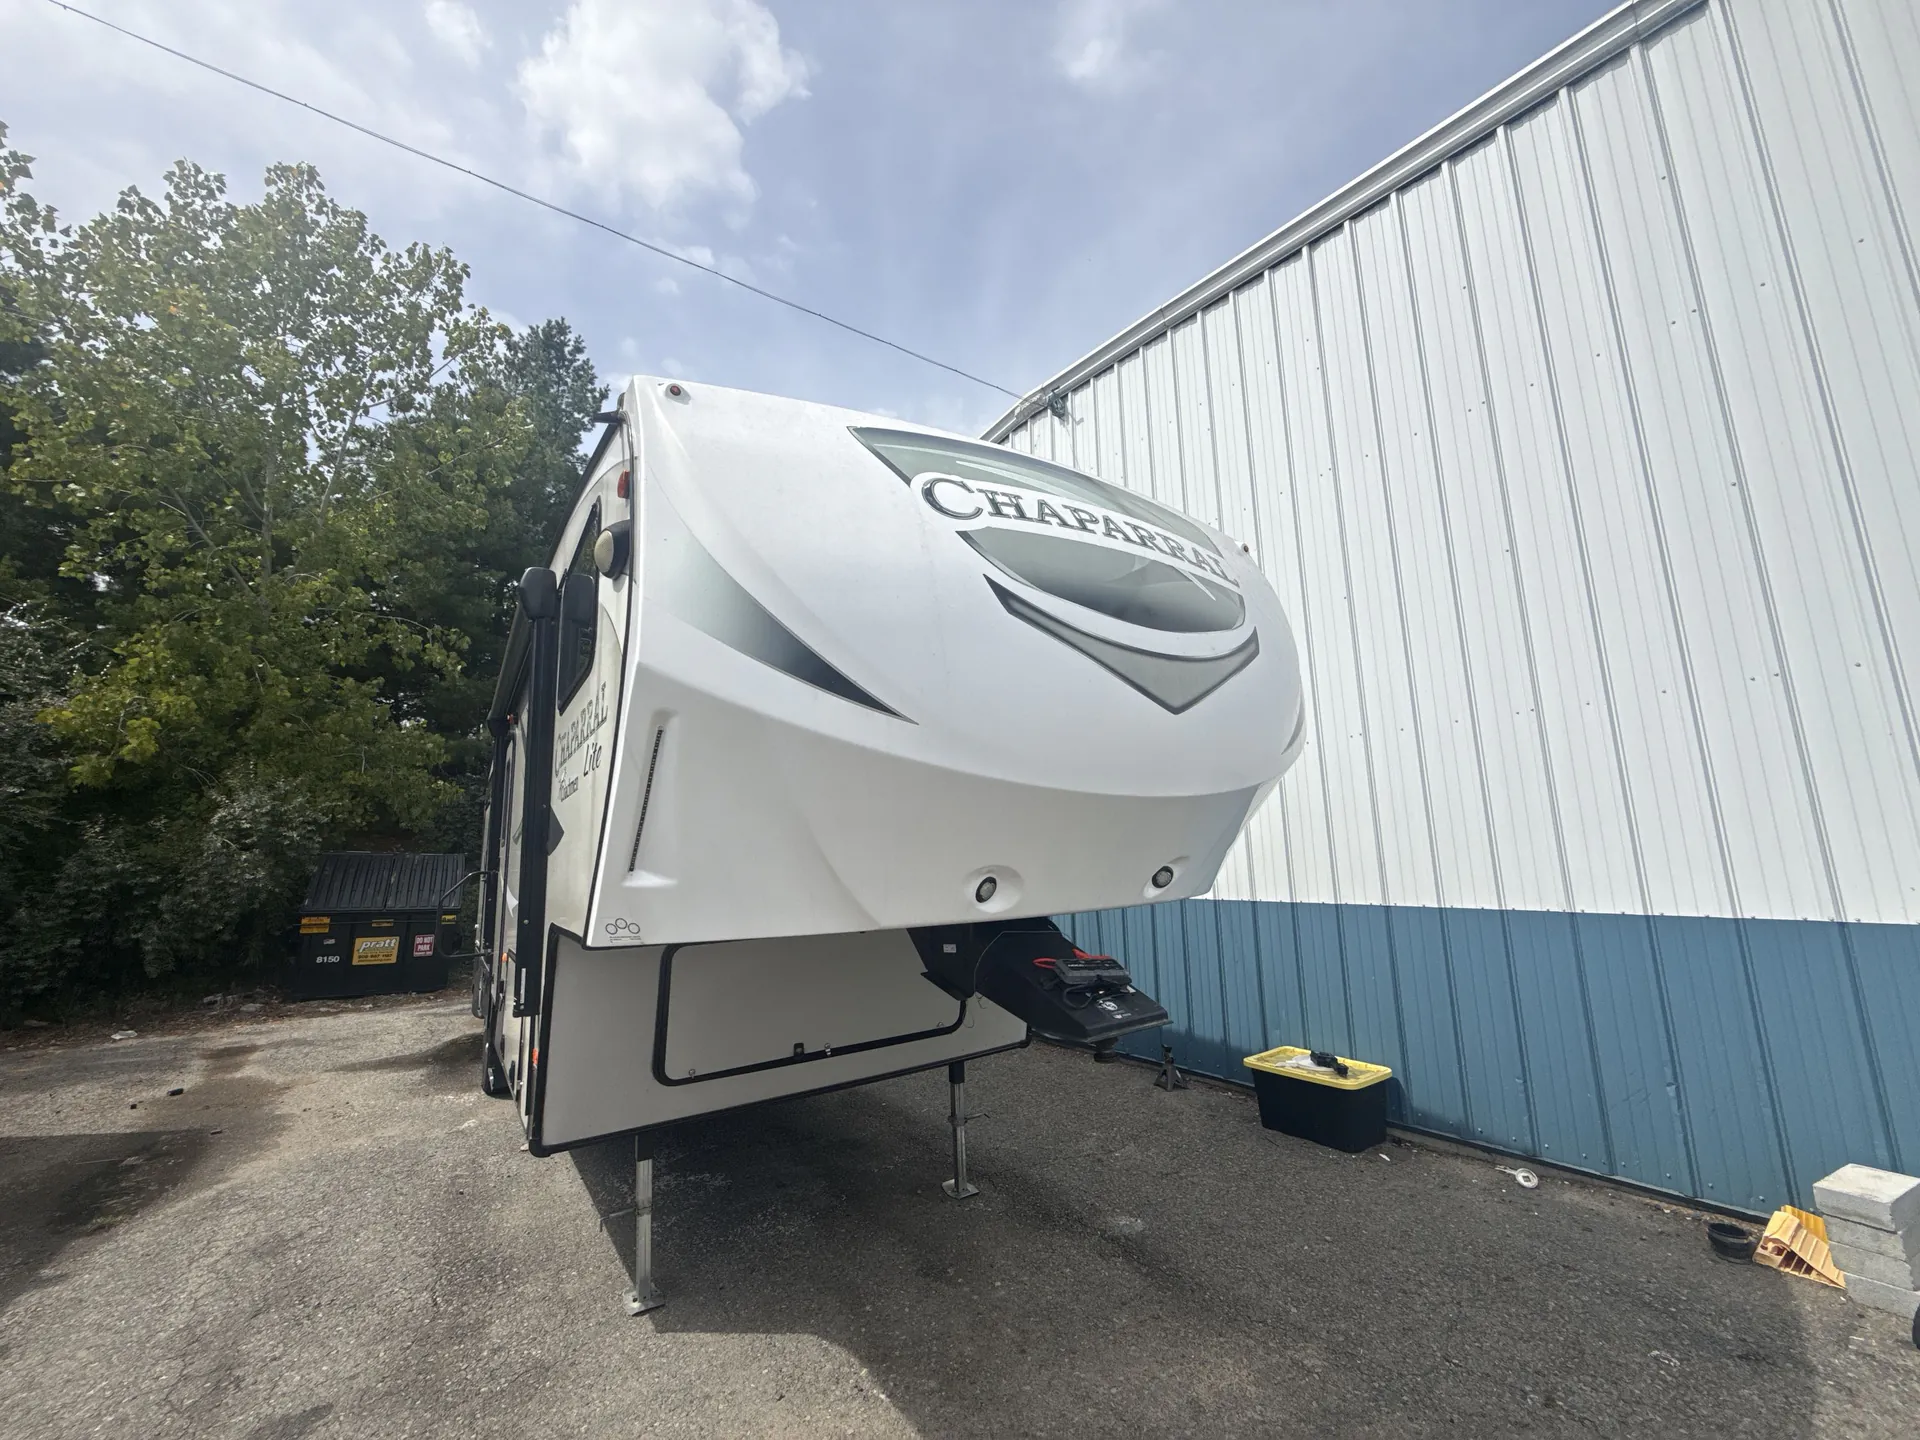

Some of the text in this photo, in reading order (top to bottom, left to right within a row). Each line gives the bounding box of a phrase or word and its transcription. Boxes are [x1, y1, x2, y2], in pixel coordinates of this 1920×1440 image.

[921, 477, 1240, 588] CHAPARRAL
[554, 681, 609, 777] CHAPARRAL
[583, 742, 603, 777] Lite
[316, 955, 340, 964] 8150
[359, 938, 397, 953] pratt
